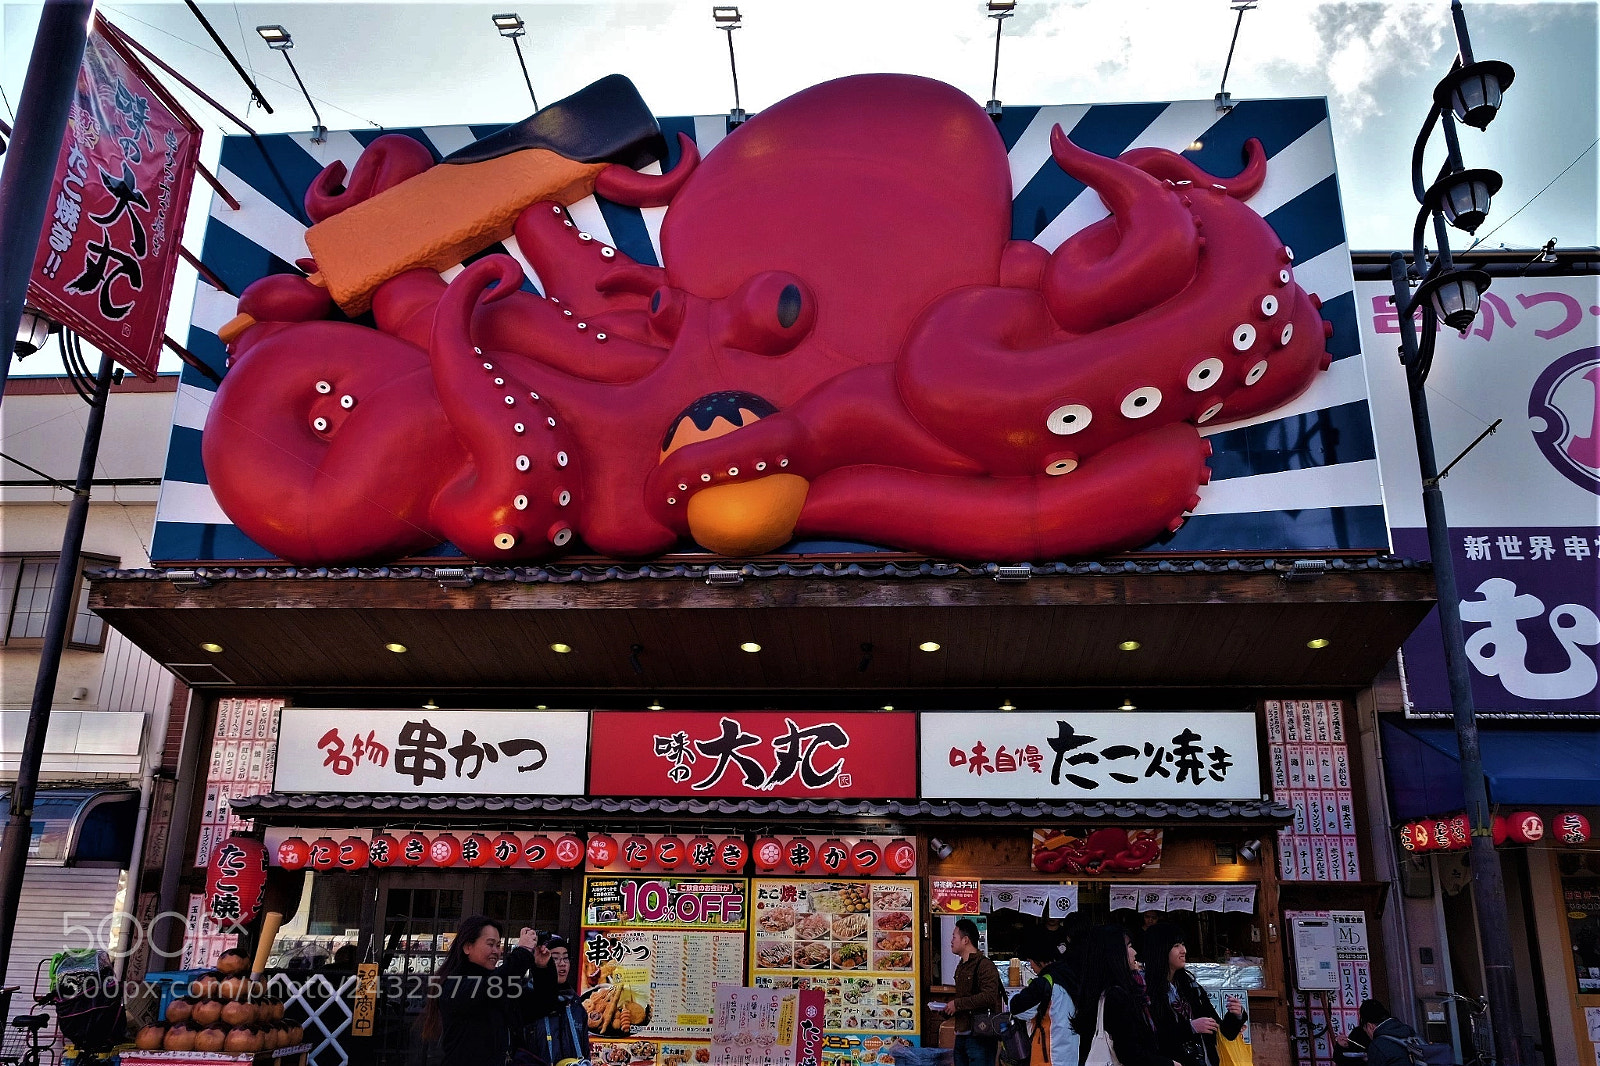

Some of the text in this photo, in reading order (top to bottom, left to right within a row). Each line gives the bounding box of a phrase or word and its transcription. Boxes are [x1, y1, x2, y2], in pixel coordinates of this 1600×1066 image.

[1295, 803, 1305, 832] ベーコン
[1310, 801, 1322, 833] チャンジャ
[1326, 804, 1336, 829] もち
[1341, 804, 1352, 829] 明太子
[1284, 850, 1293, 875] コーン
[1299, 850, 1310, 875] チーズ
[1346, 850, 1357, 875] キムチ
[1342, 968, 1354, 1006] ロースハム
